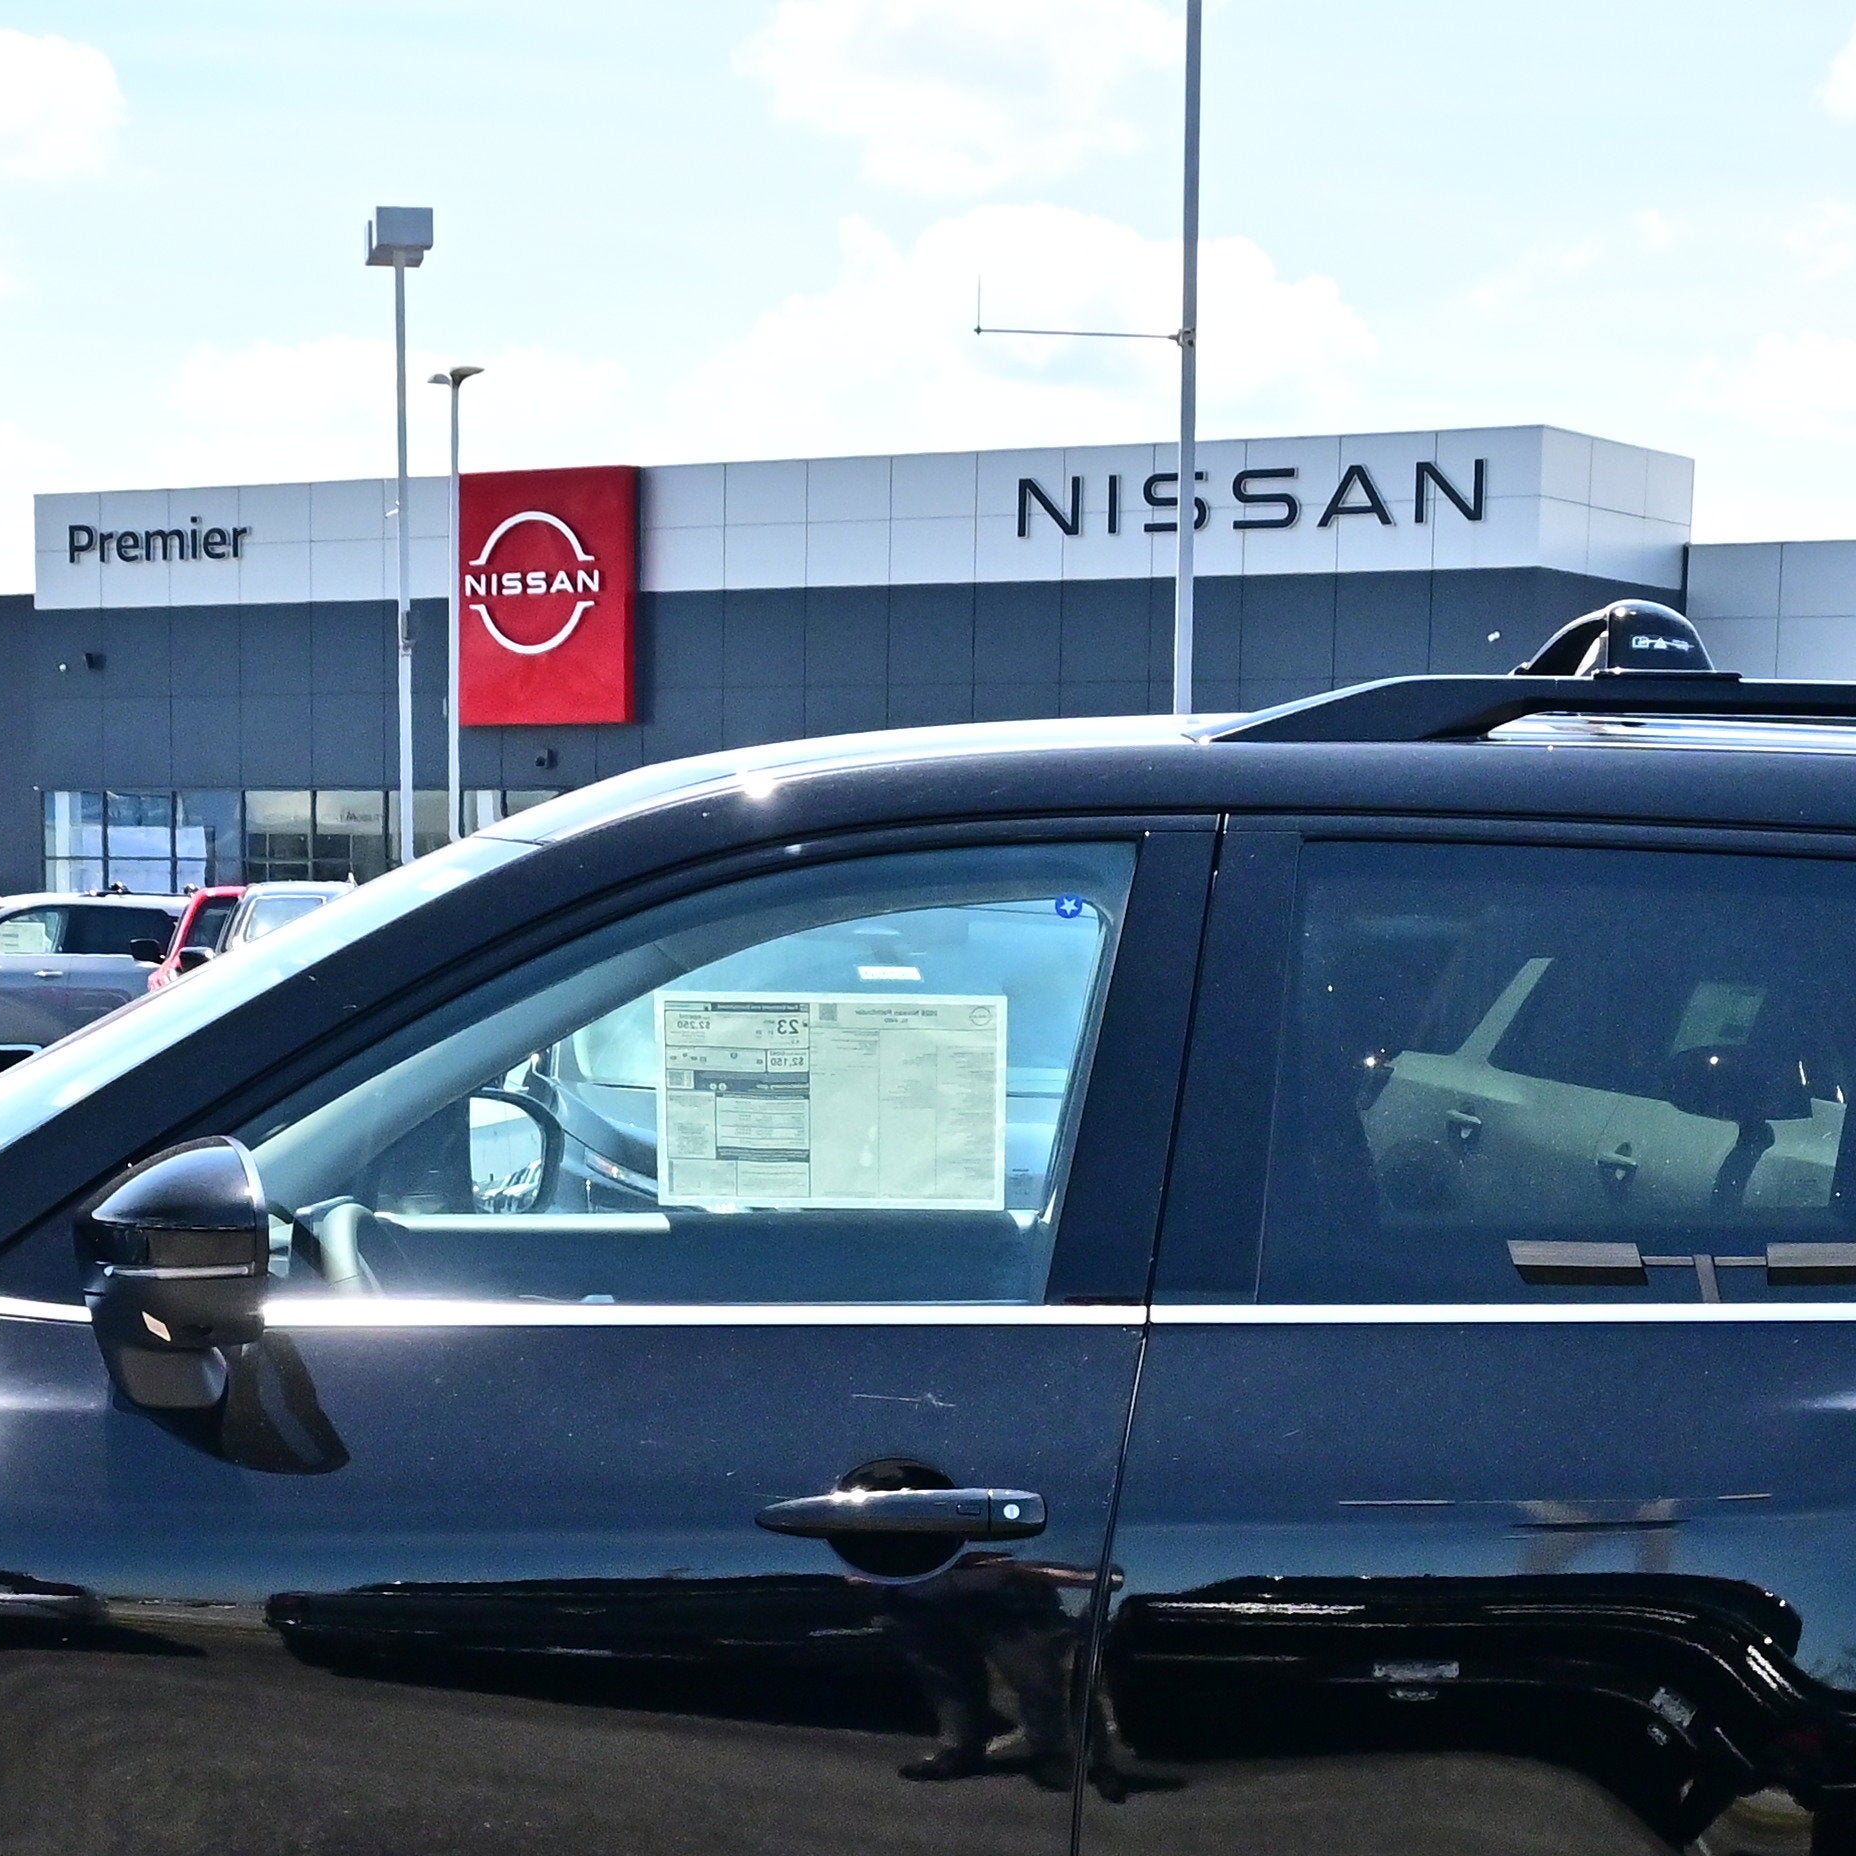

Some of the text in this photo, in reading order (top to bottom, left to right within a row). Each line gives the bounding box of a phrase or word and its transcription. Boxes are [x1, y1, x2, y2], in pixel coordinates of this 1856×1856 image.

[1017, 458, 1486, 539] NISSAN
[68, 515, 251, 564] Premier
[464, 569, 600, 597] NISSAN
